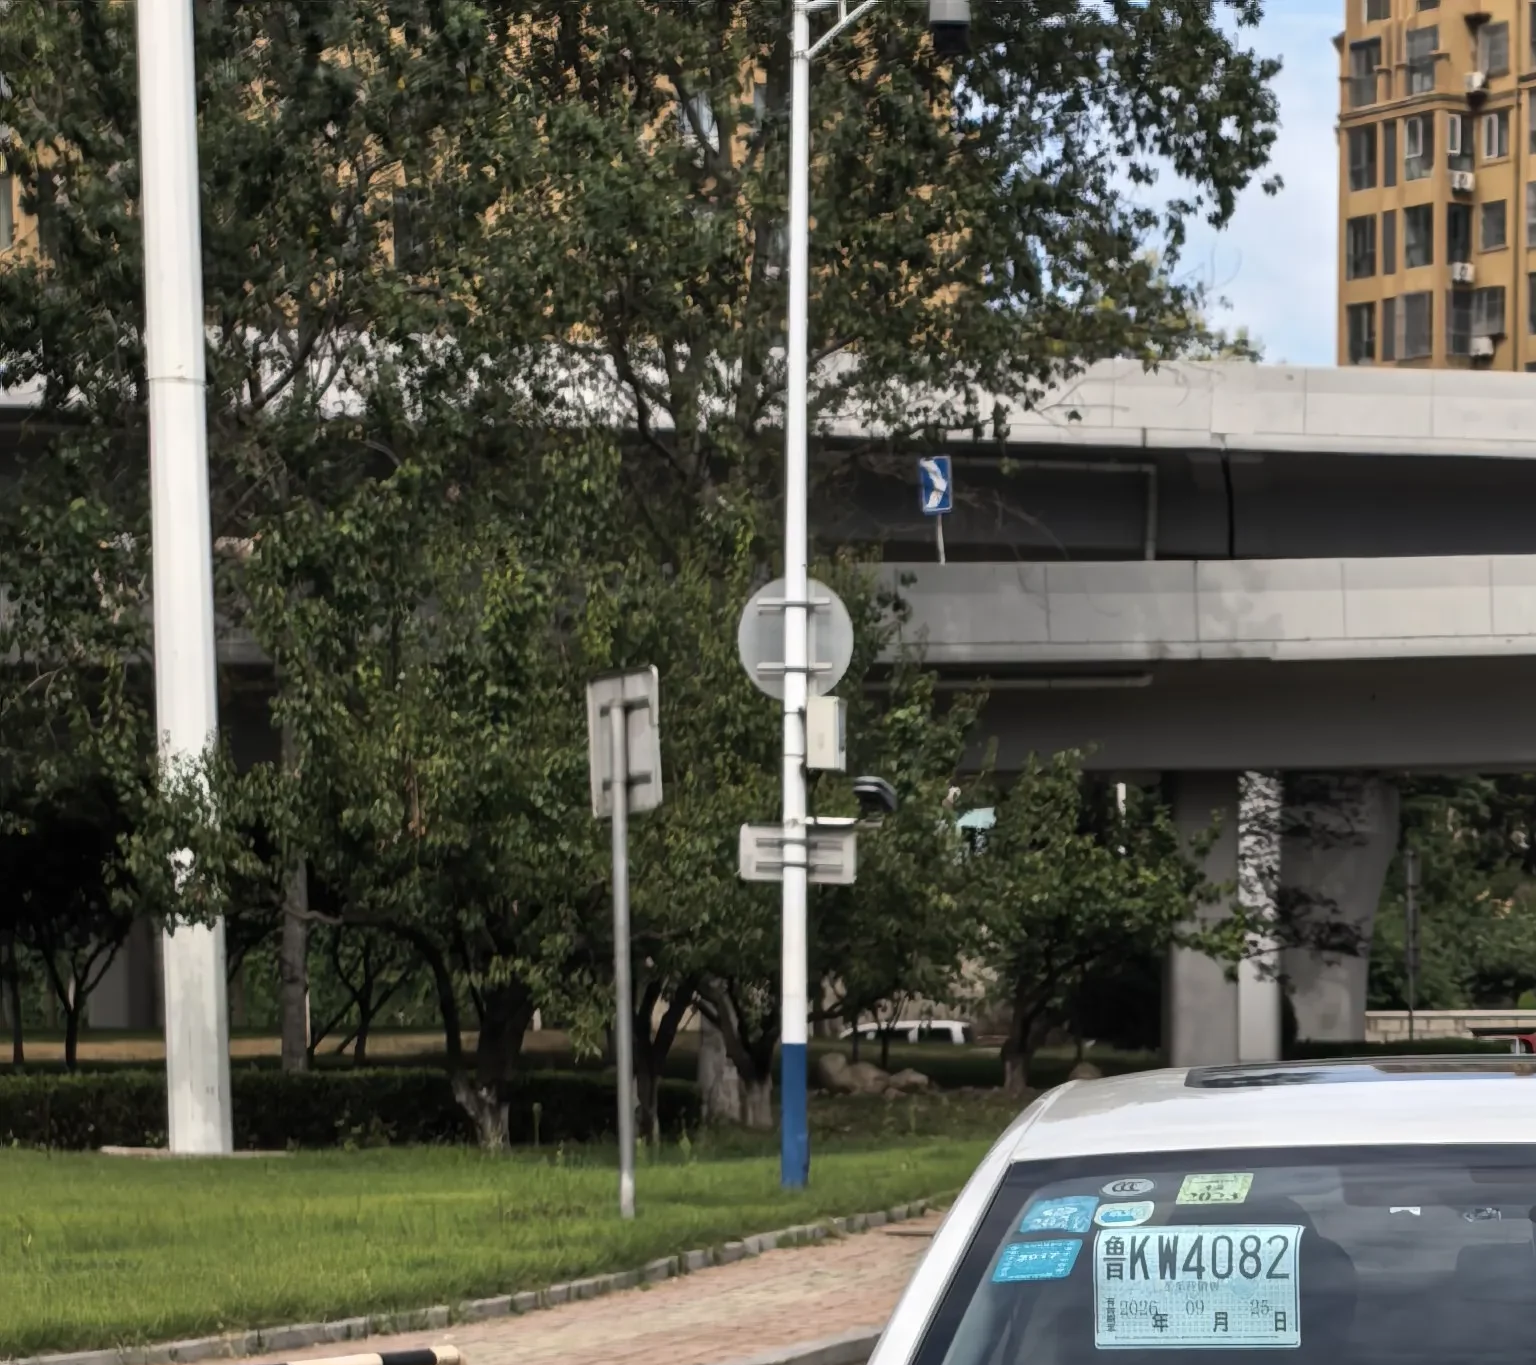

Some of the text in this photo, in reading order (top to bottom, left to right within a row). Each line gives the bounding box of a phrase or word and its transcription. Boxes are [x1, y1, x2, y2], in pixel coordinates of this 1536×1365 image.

[1103, 1234, 1290, 1281] 鲁KW4082
[1119, 1300, 1158, 1317] 2026
[1152, 1313, 1169, 1333] 年
[1185, 1300, 1205, 1316] 09
[1213, 1311, 1229, 1333] 月
[1274, 1311, 1287, 1332] 日
